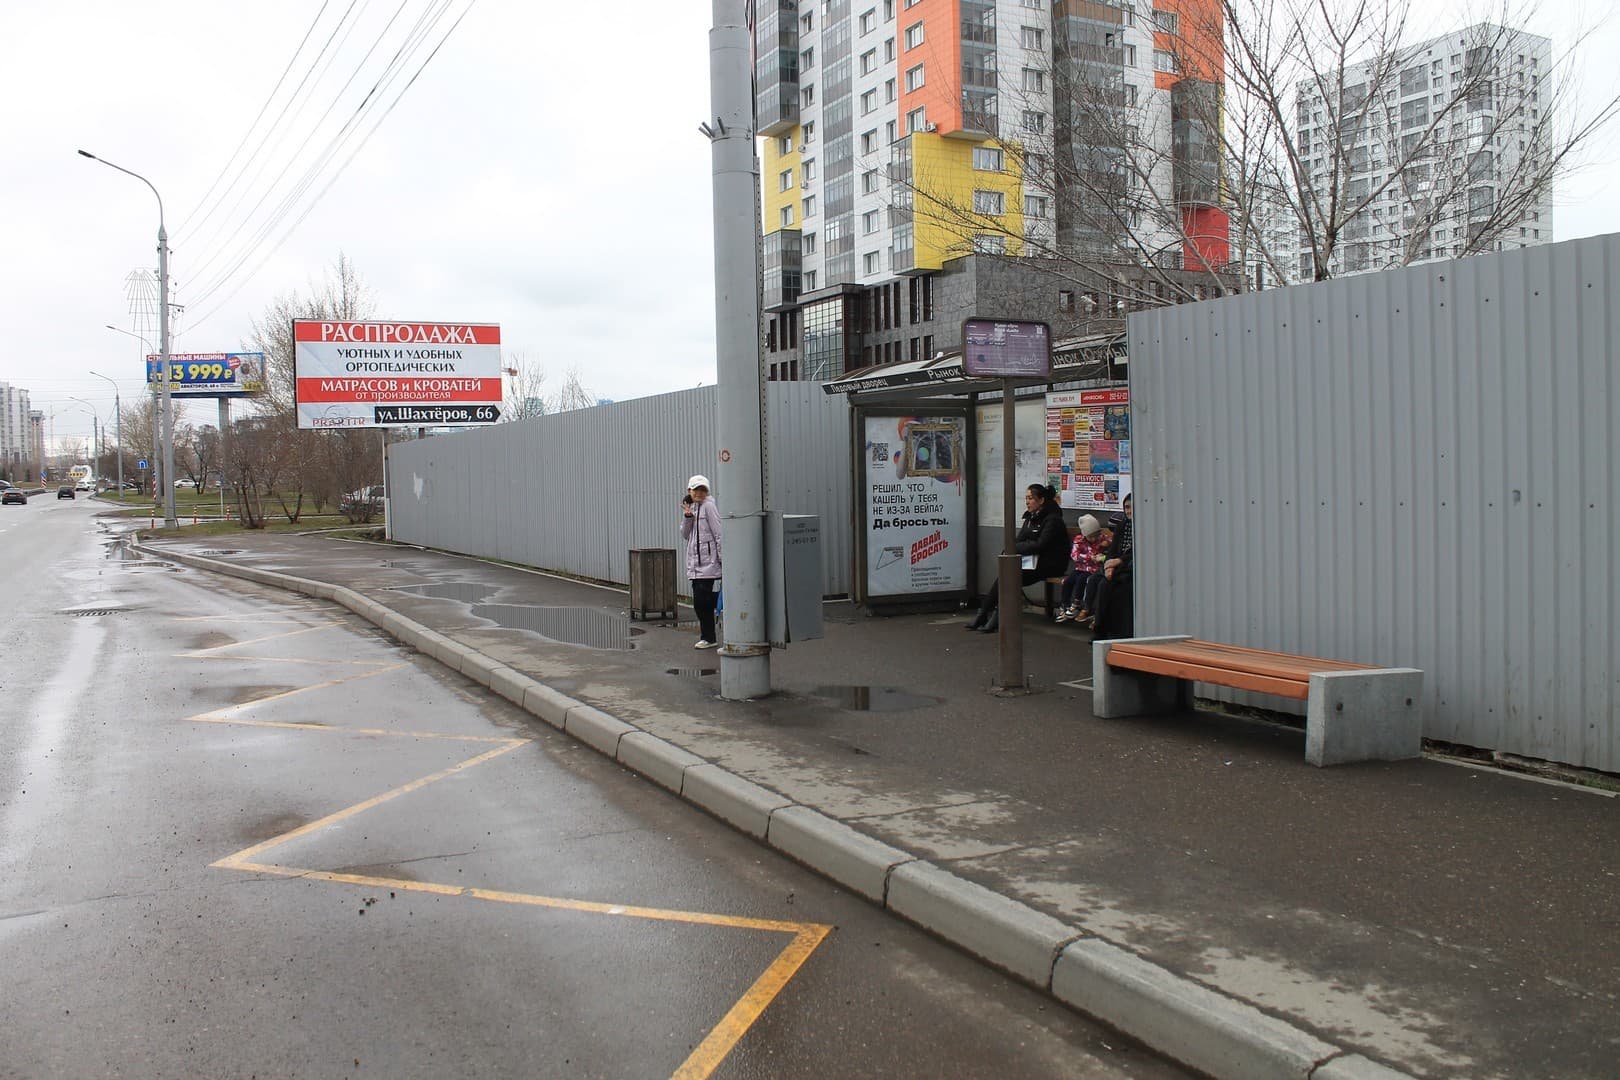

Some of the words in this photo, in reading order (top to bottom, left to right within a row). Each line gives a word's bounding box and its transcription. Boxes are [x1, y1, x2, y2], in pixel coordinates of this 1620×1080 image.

[321, 324, 477, 343] РАСПРОДАЖА
[337, 348, 391, 359] УЮТНЫХ
[394, 349, 403, 359] И
[406, 349, 463, 360] УДОБНЫХ
[188, 363, 223, 380] 999
[345, 361, 456, 373] ОРТОПЕДИЧЕСКИХ
[321, 378, 398, 392] МАТРАСОВ
[413, 377, 481, 392] КРОВАТЕЙ
[371, 391, 451, 402] производителя
[476, 406, 493, 420] 66
[872, 484, 904, 493] РЕШИЛ,
[908, 483, 925, 492] ЧТО
[872, 496, 906, 504] КАШЕЛЬ
[909, 494, 915, 503] У
[918, 493, 938, 502] ТЕБЯ
[872, 506, 884, 515] НЕ
[886, 505, 911, 515] ИЗ-ЗА
[914, 503, 944, 513] ВЕЙПА?
[873, 518, 891, 530] Да
[892, 518, 929, 529] брось
[930, 518, 949, 526] ты.
[911, 529, 941, 555] ДАВАЙ
[911, 539, 949, 565] БРОСАТЬ
